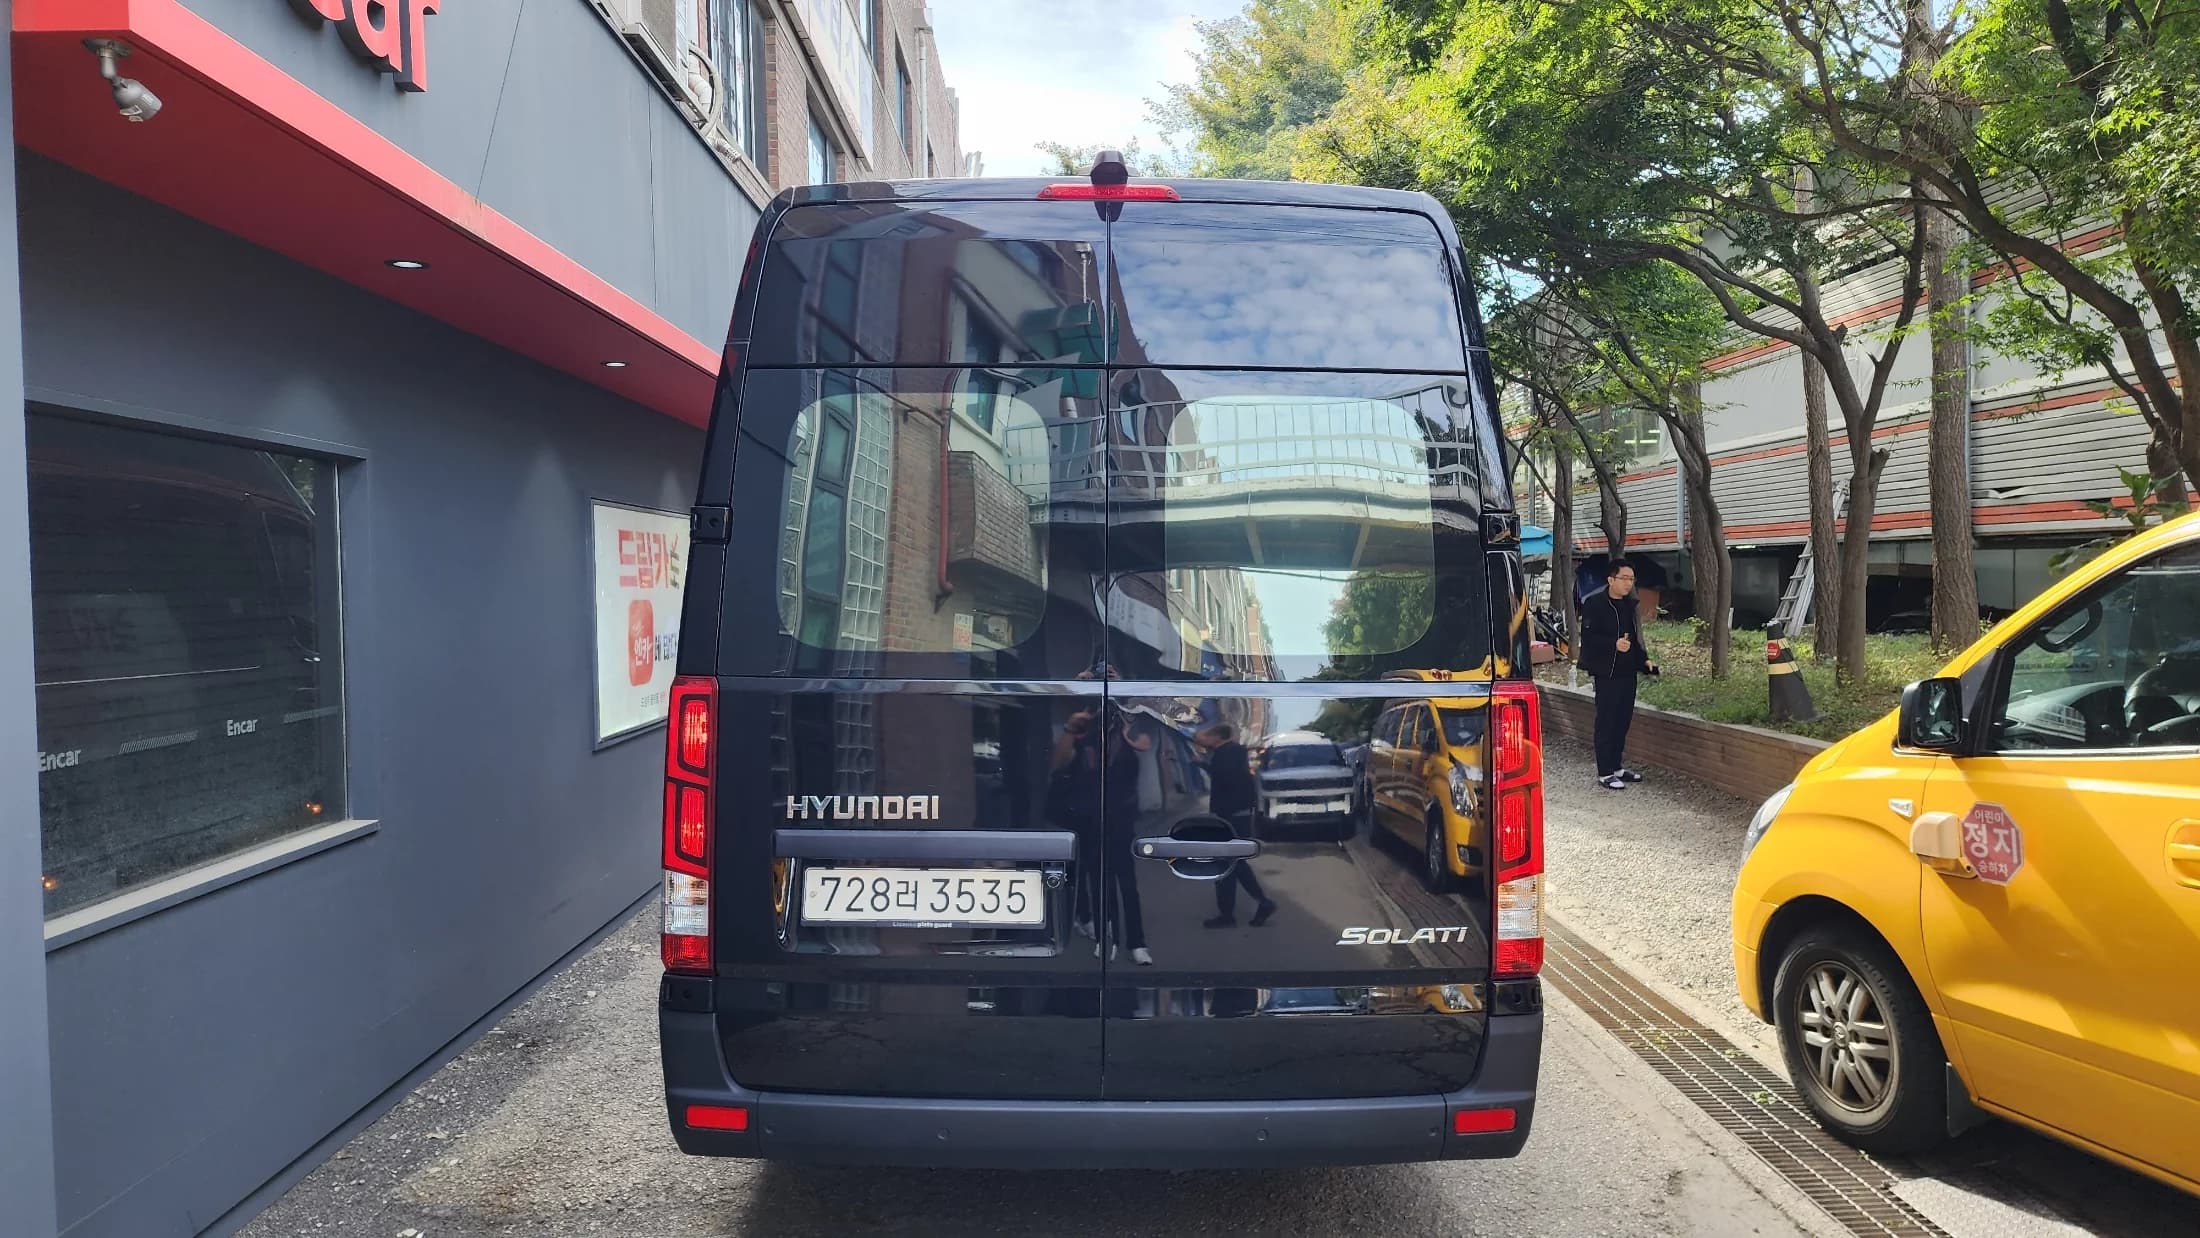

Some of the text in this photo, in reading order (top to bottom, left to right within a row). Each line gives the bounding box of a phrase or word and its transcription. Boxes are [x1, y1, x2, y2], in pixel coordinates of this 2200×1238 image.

[226, 719, 258, 737] Encar
[38, 750, 81, 773] Encar
[786, 795, 939, 820] HYUNDAI
[1974, 809, 2004, 825] 어린이
[1963, 822, 2018, 864] 정지
[1978, 860, 2009, 876] 승하차
[929, 878, 1026, 914] 3535
[1336, 926, 1468, 945] SOLATI
